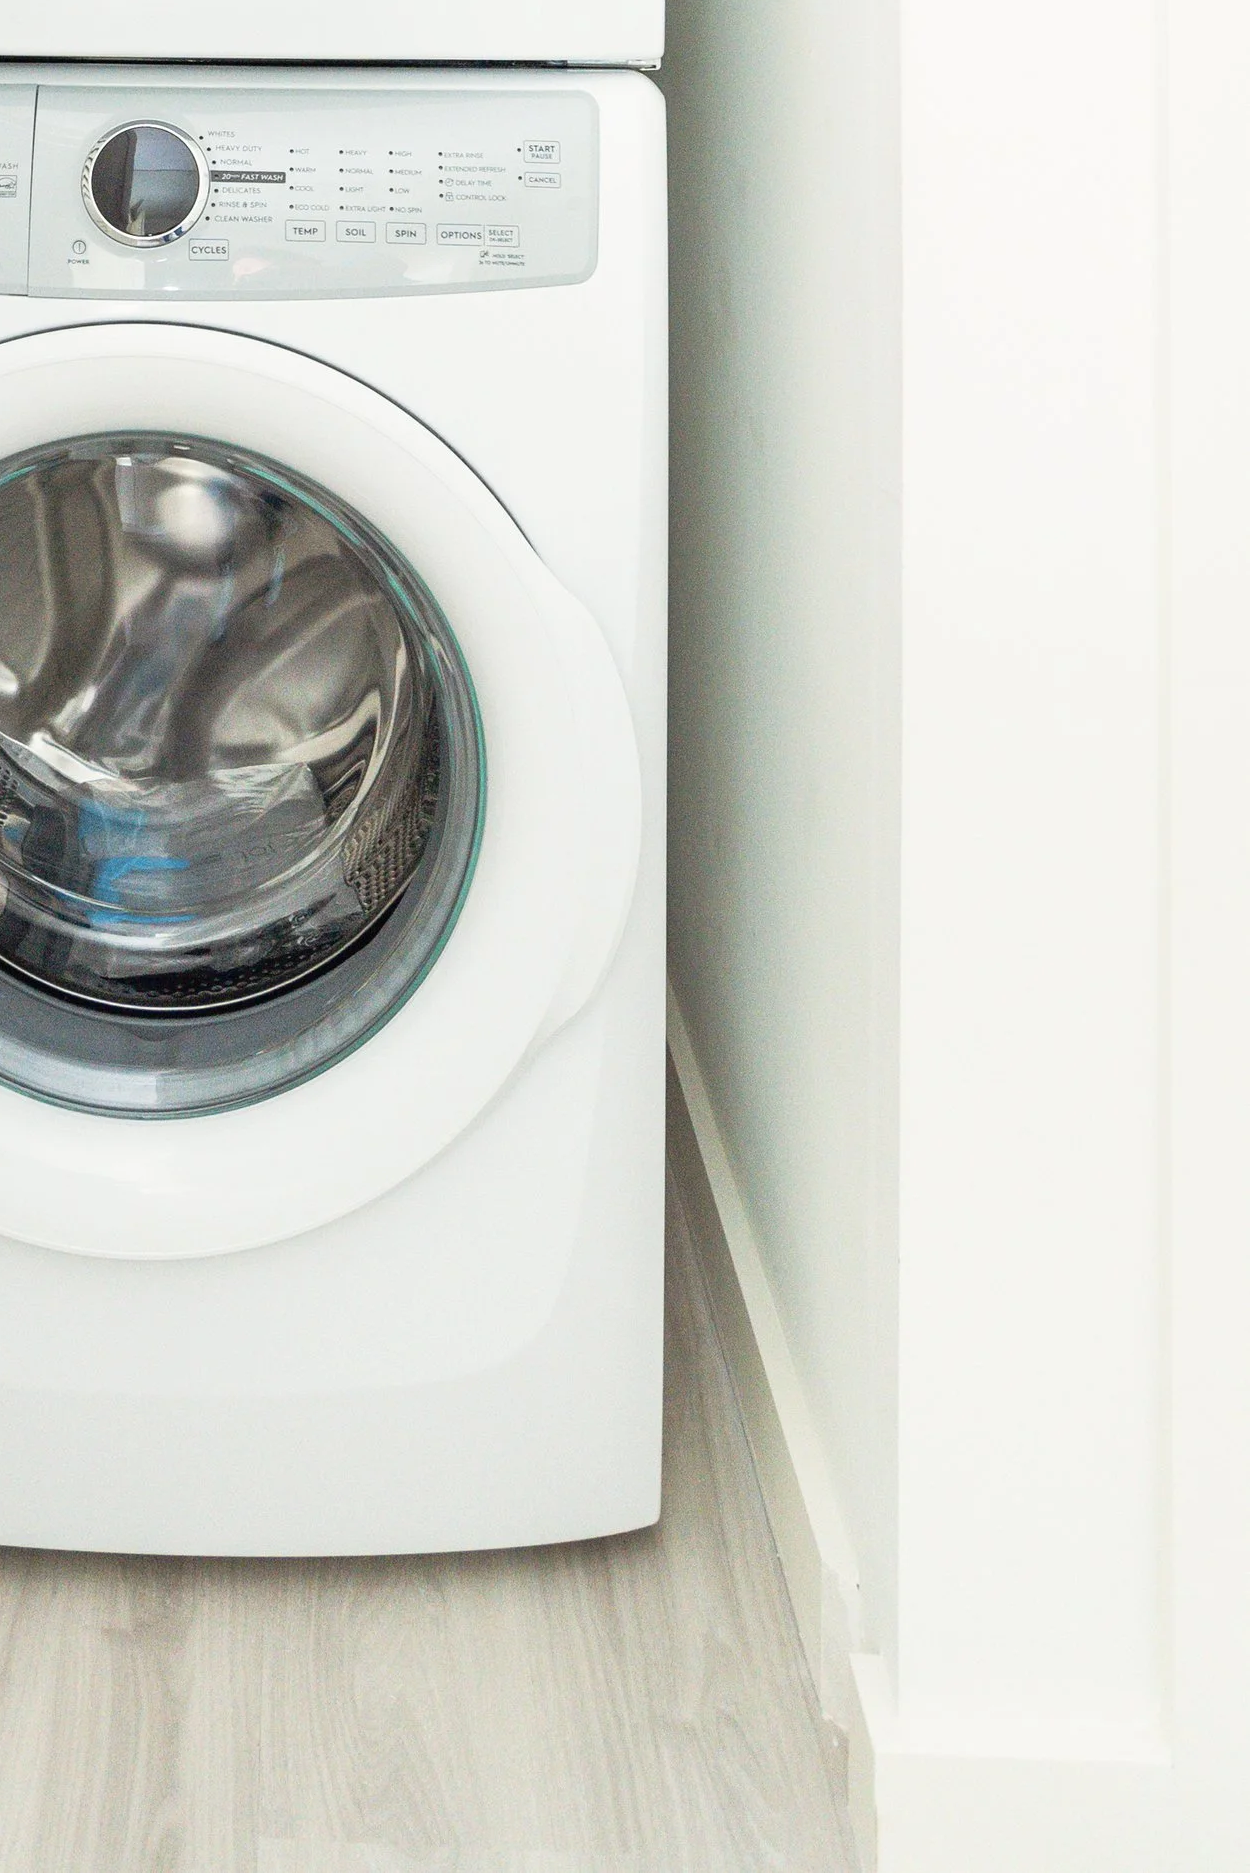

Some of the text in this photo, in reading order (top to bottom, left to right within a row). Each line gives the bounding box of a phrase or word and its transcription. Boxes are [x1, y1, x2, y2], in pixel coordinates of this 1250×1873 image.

[528, 144, 555, 153] START
[240, 173, 259, 181] FAST
[260, 173, 284, 181] WASH
[214, 215, 273, 224] CLEAN WASHER
[292, 227, 318, 236] TEMP
[345, 228, 367, 237] SOIL
[395, 229, 417, 238] SPIN
[440, 230, 482, 240] OPTIONS
[191, 245, 227, 255] CYCLES
